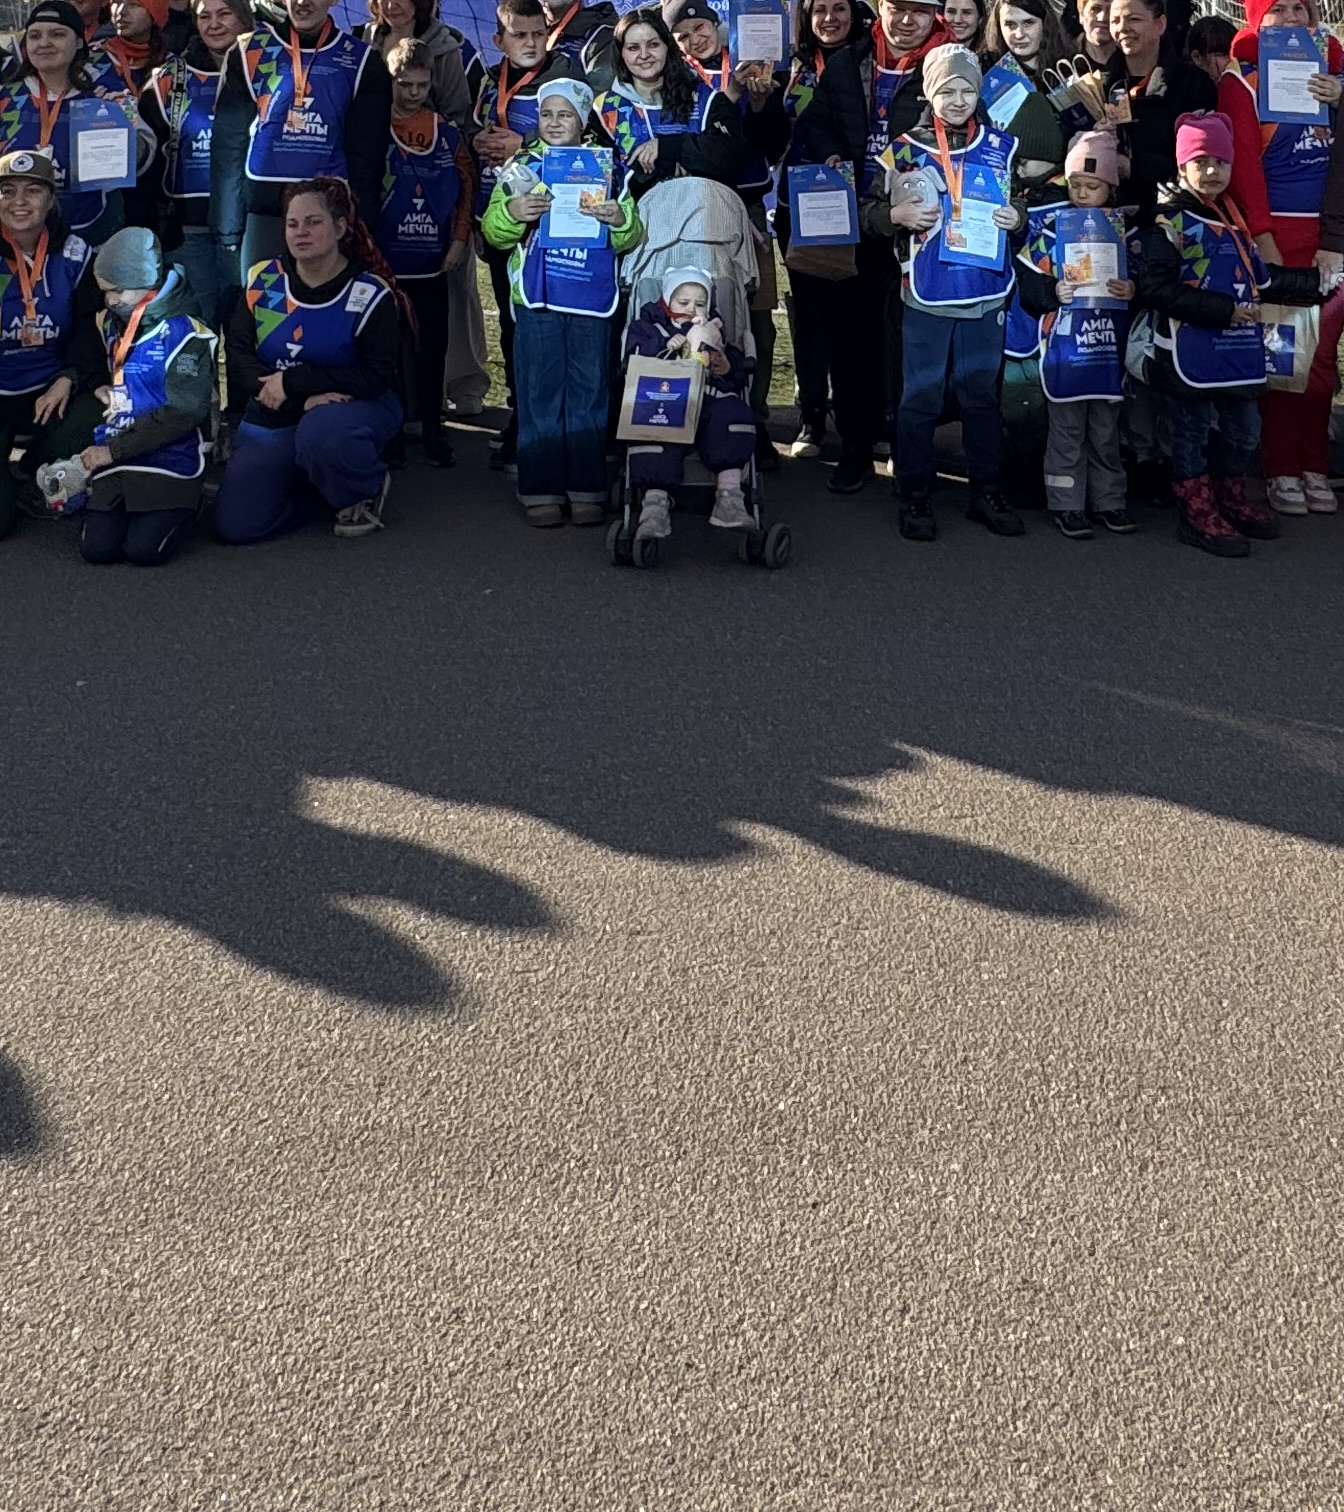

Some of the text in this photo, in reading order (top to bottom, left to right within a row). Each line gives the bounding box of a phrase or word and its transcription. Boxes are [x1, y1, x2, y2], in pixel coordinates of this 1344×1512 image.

[403, 212, 434, 224] ЛИГА
[397, 223, 439, 235] МЕЧТЫ
[1080, 317, 1116, 333] ЛИГА
